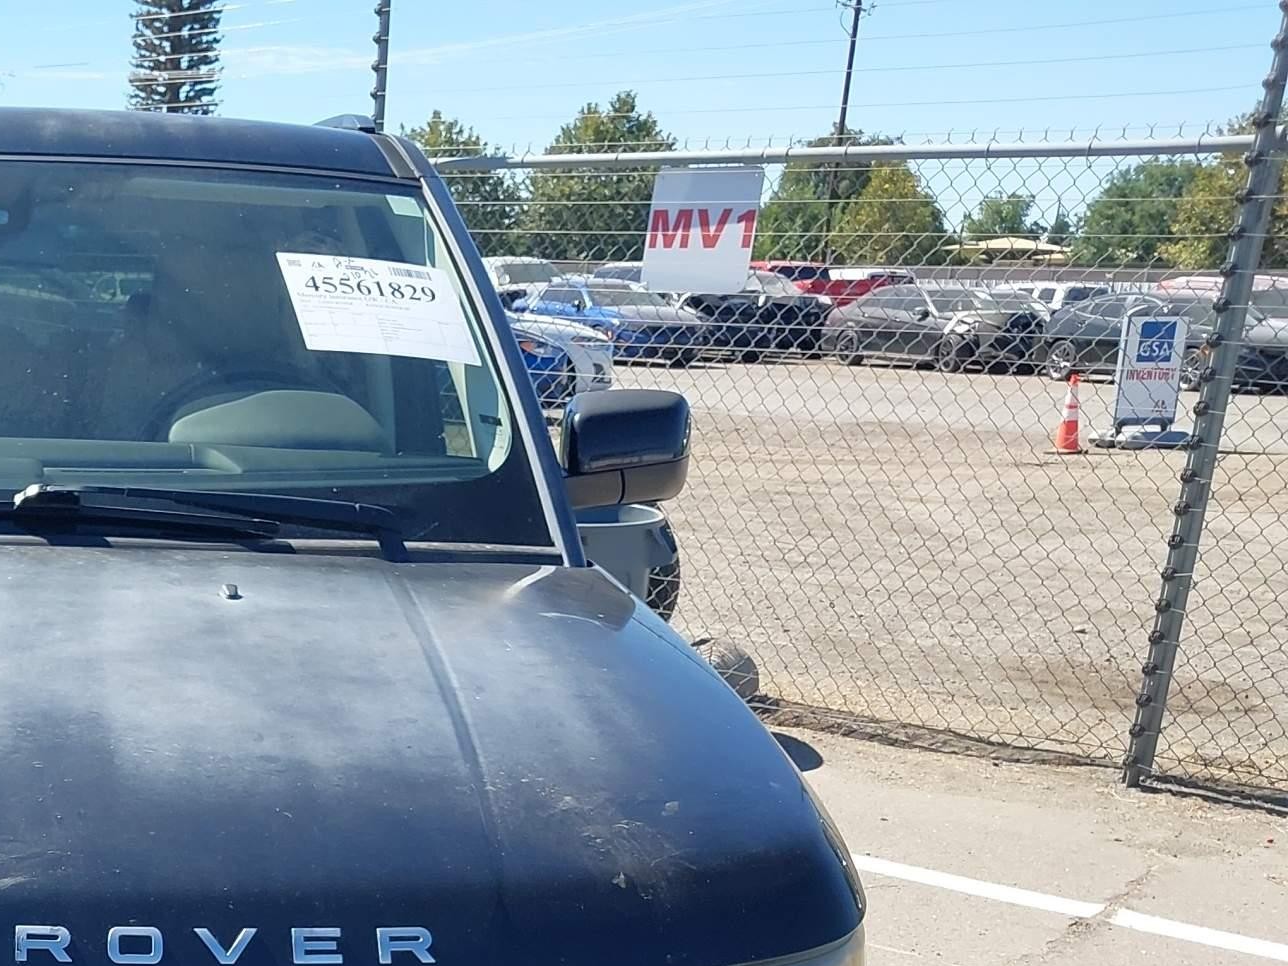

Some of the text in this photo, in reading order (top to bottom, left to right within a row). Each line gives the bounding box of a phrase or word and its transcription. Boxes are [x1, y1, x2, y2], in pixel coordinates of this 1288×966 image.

[649, 208, 757, 249] MV1
[304, 275, 437, 303] 45561829
[1139, 341, 1172, 357] GSA
[1126, 367, 1177, 380] INVENTORY
[14, 924, 437, 964] ROVER
